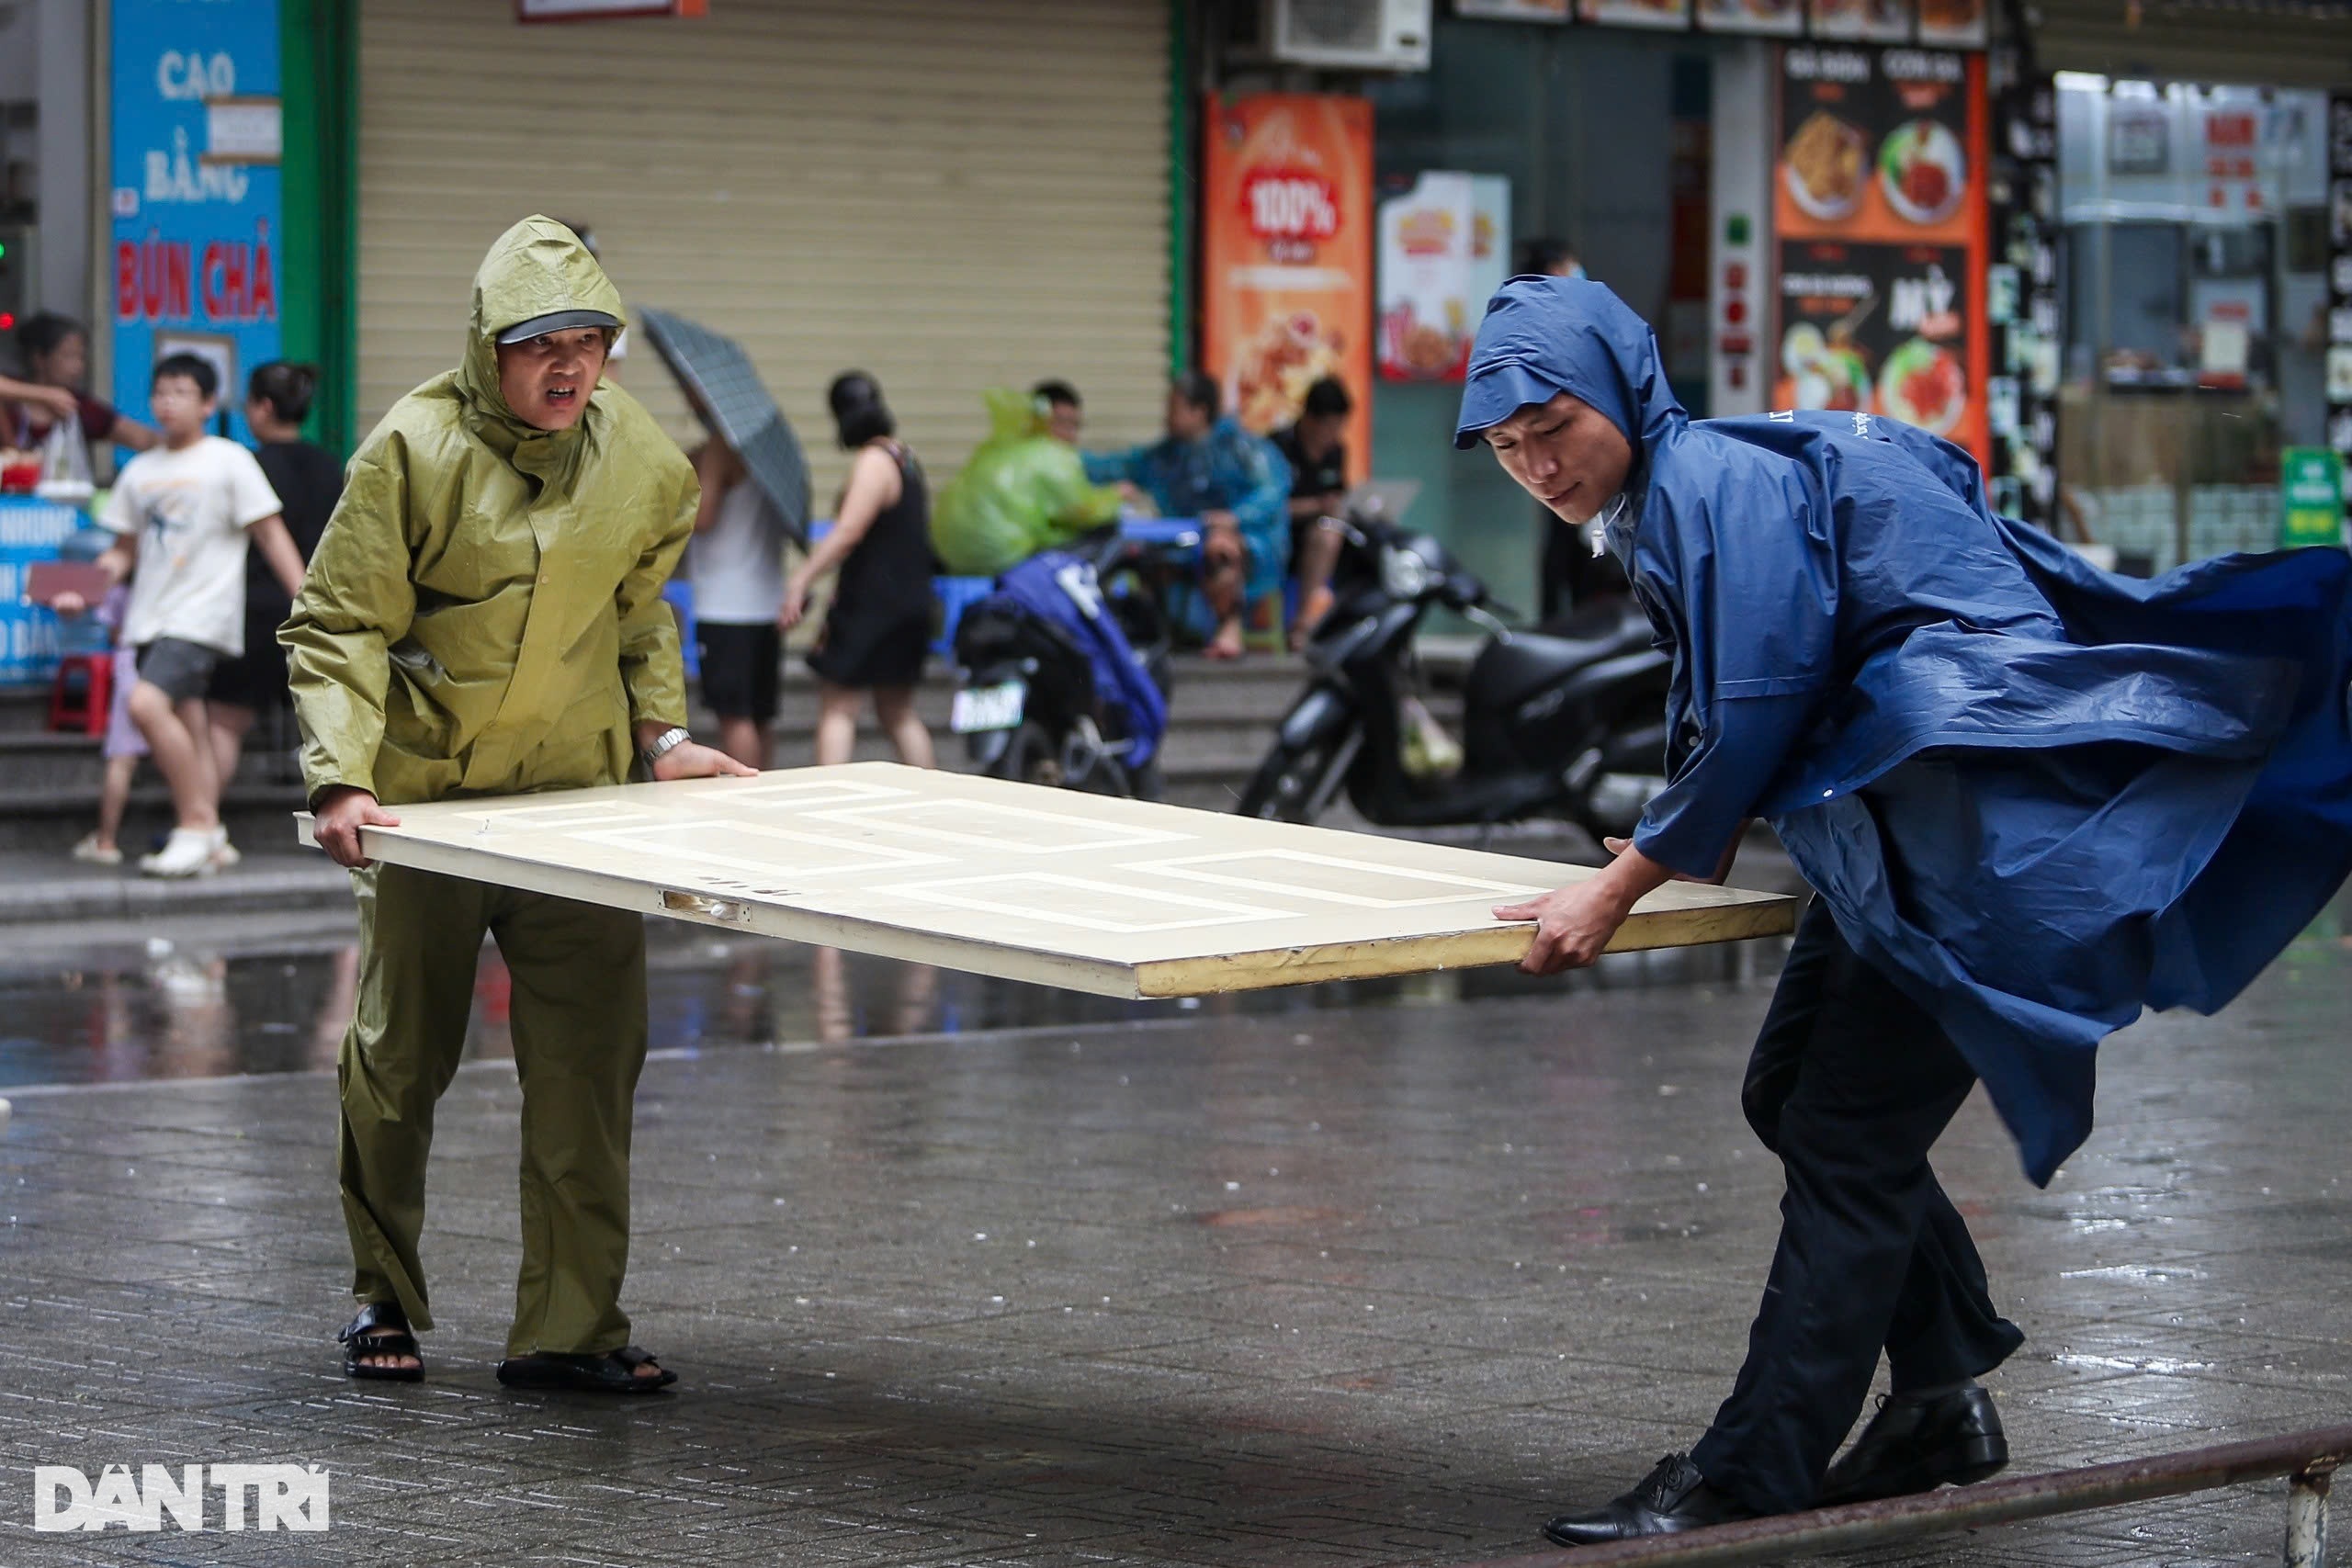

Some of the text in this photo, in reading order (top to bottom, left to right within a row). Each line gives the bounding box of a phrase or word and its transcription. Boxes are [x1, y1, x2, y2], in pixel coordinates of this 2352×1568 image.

[156, 50, 236, 100] CAO
[1251, 177, 1338, 235] 100%
[118, 217, 278, 321] BÚN CHẢ
